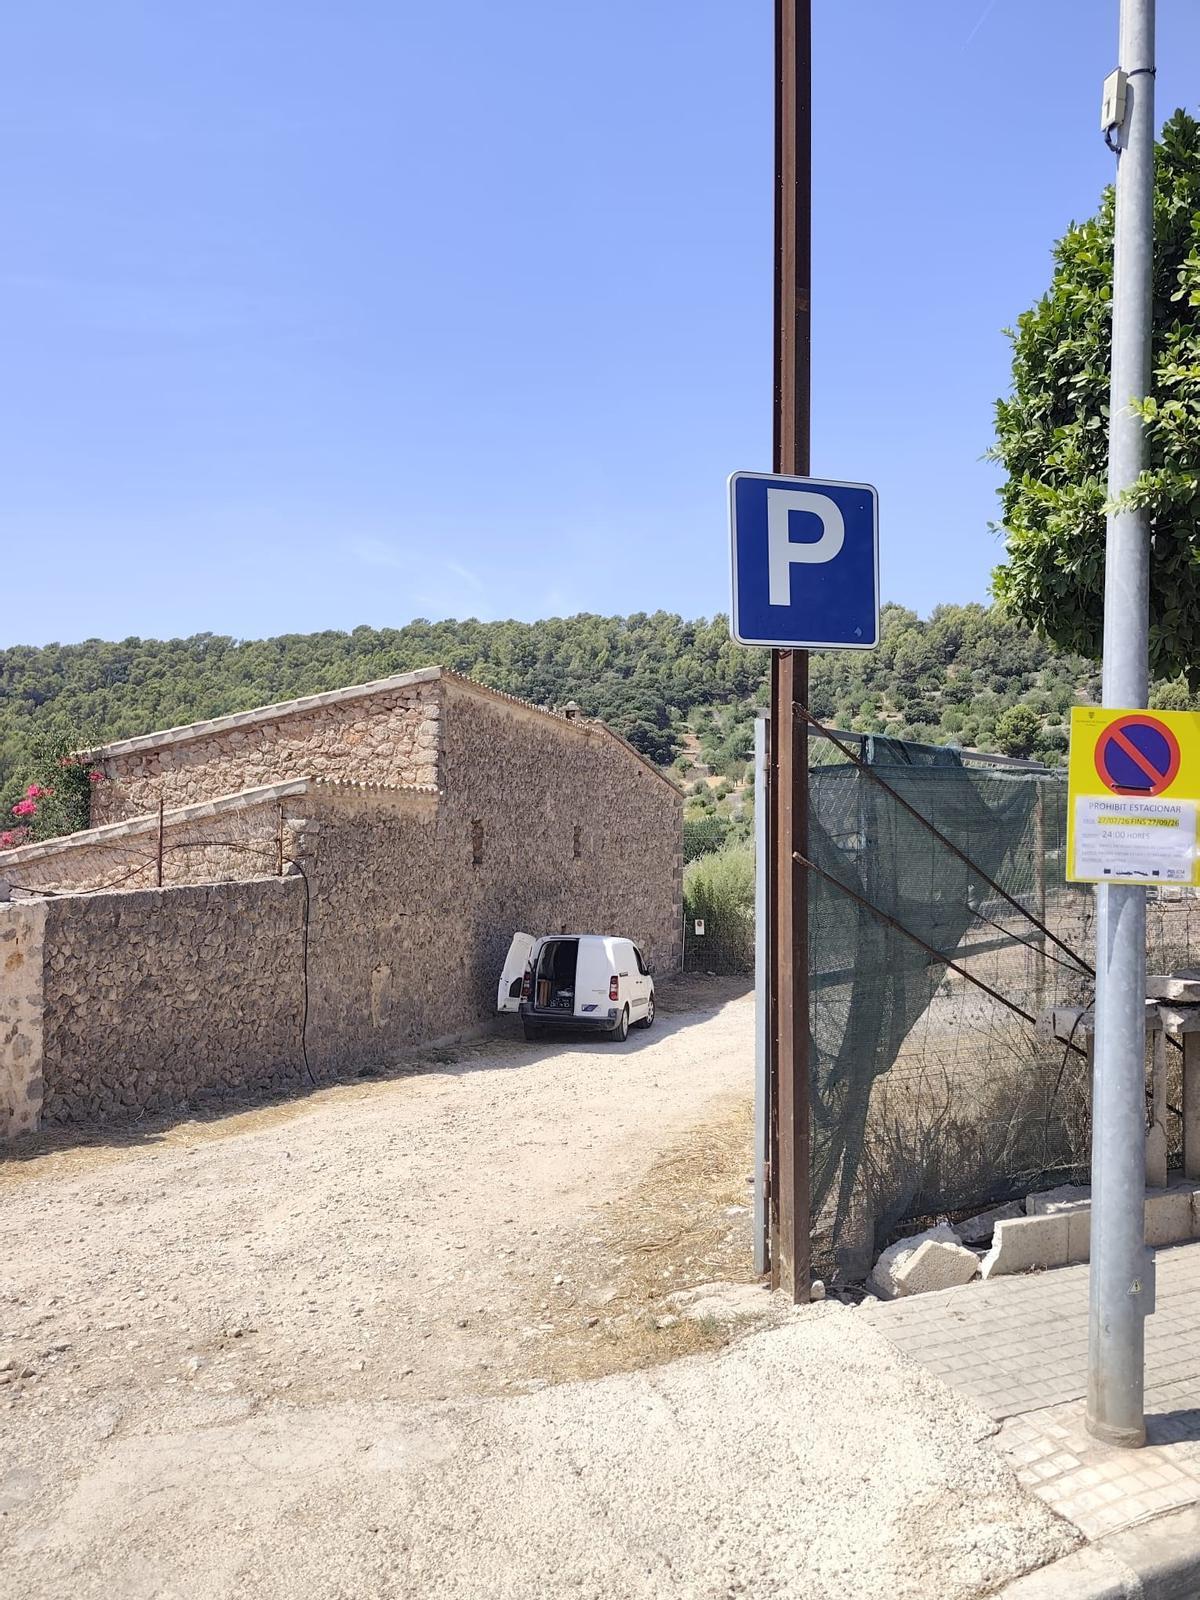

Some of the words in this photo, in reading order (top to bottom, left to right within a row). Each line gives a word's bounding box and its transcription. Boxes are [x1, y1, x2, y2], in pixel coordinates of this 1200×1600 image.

[767, 487, 845, 606] P
[1089, 802, 1126, 811] PROHIBIT
[1129, 804, 1182, 814] ESTACIONAR
